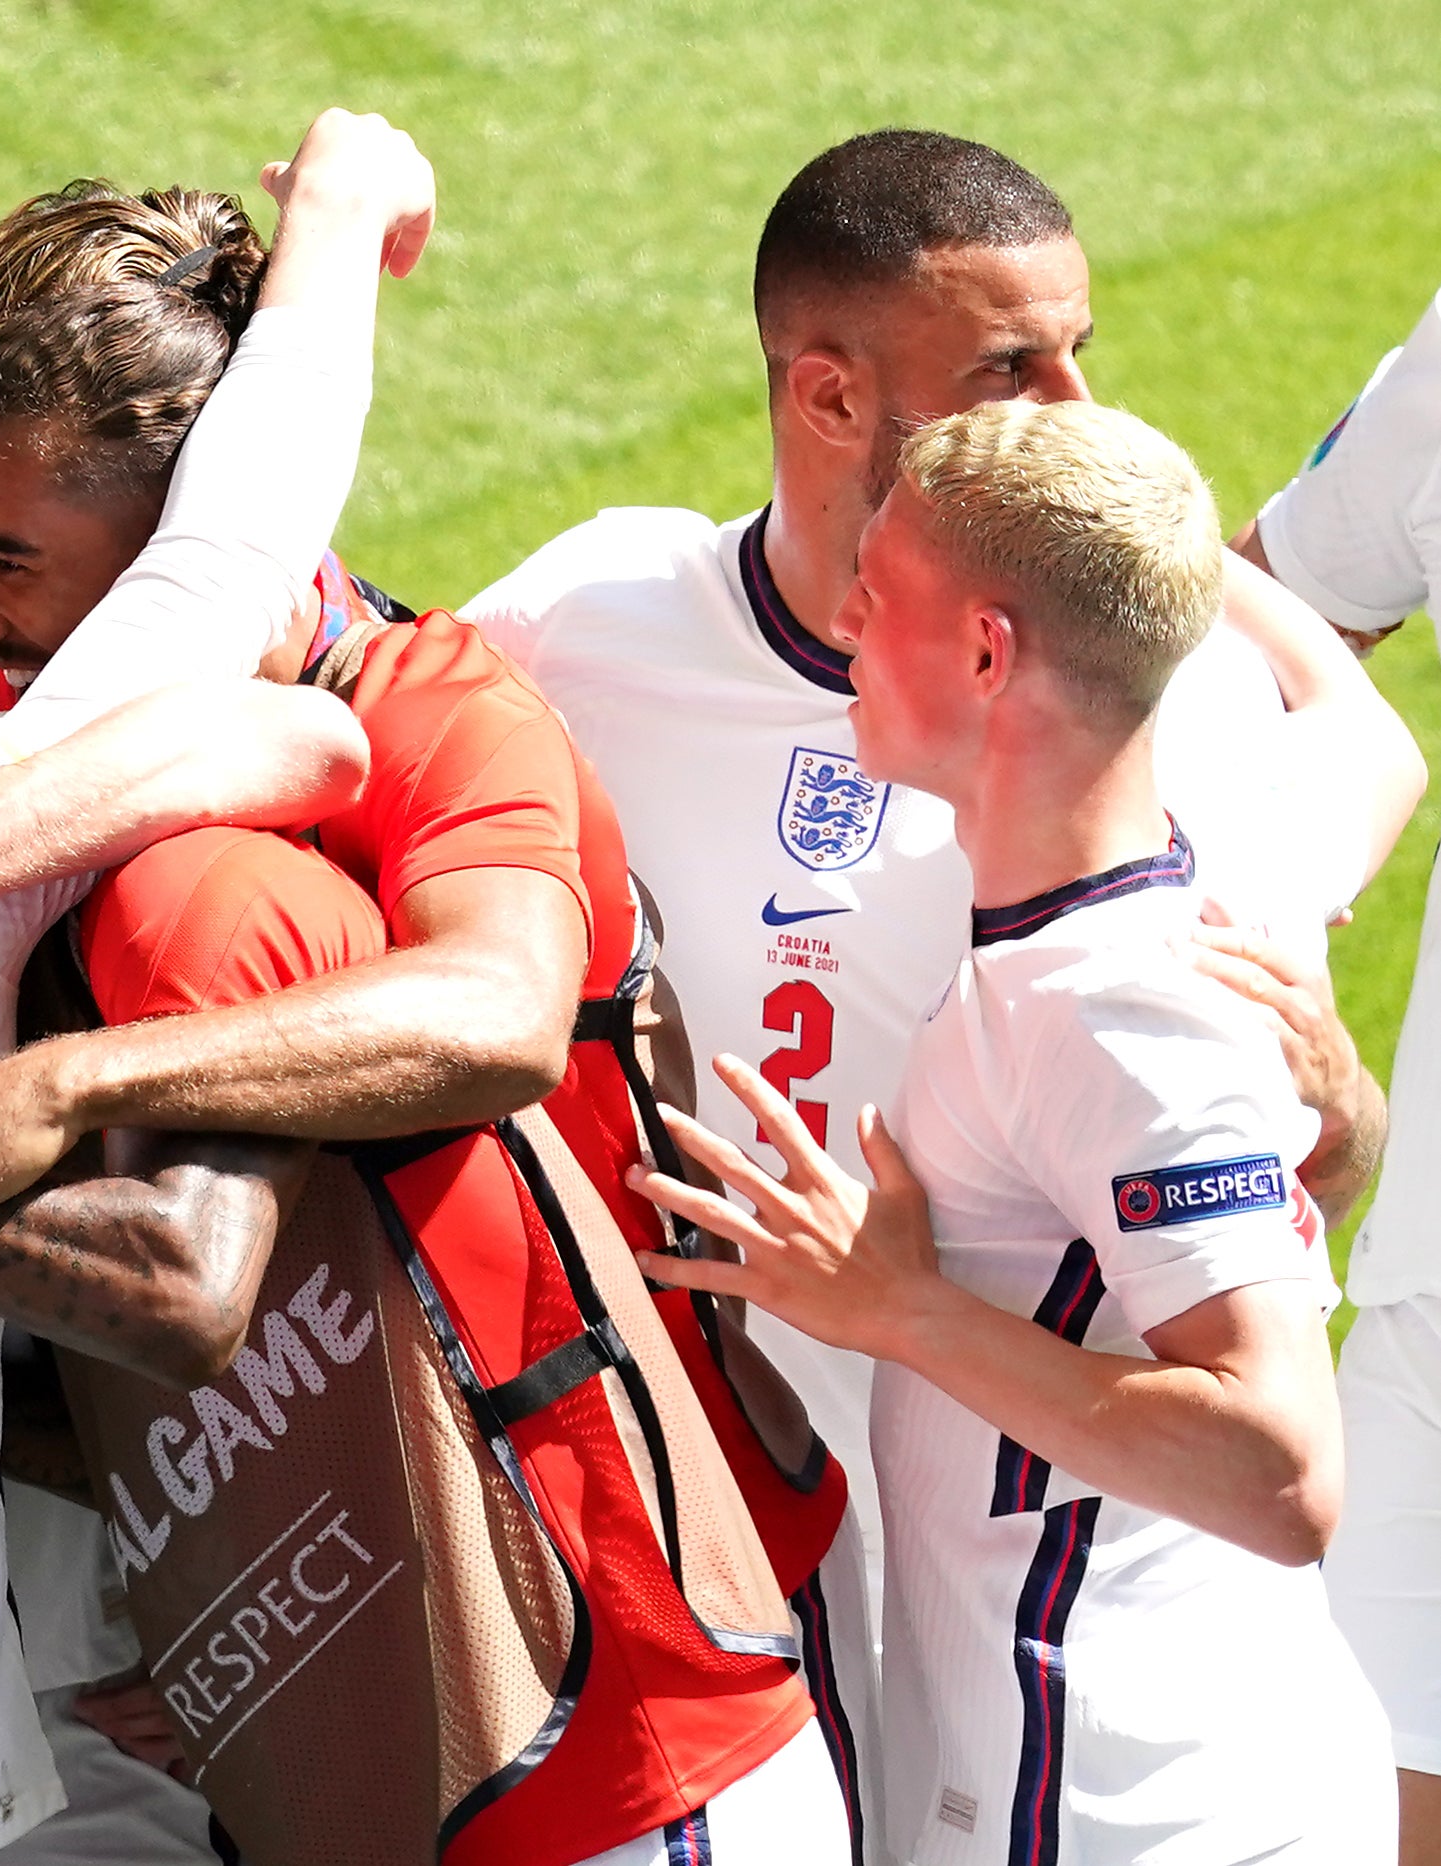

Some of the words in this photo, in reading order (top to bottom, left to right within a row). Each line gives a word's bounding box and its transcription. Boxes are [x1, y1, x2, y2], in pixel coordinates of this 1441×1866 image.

[766, 948, 779, 964] 13
[780, 951, 813, 969] JUNE
[814, 956, 840, 974] 2021
[777, 933, 831, 956] CROATIA
[756, 979, 834, 1151] 2
[1164, 1166, 1283, 1209] RESPECT
[147, 1262, 375, 1517] GAME
[163, 1508, 375, 1739] RESPECT
